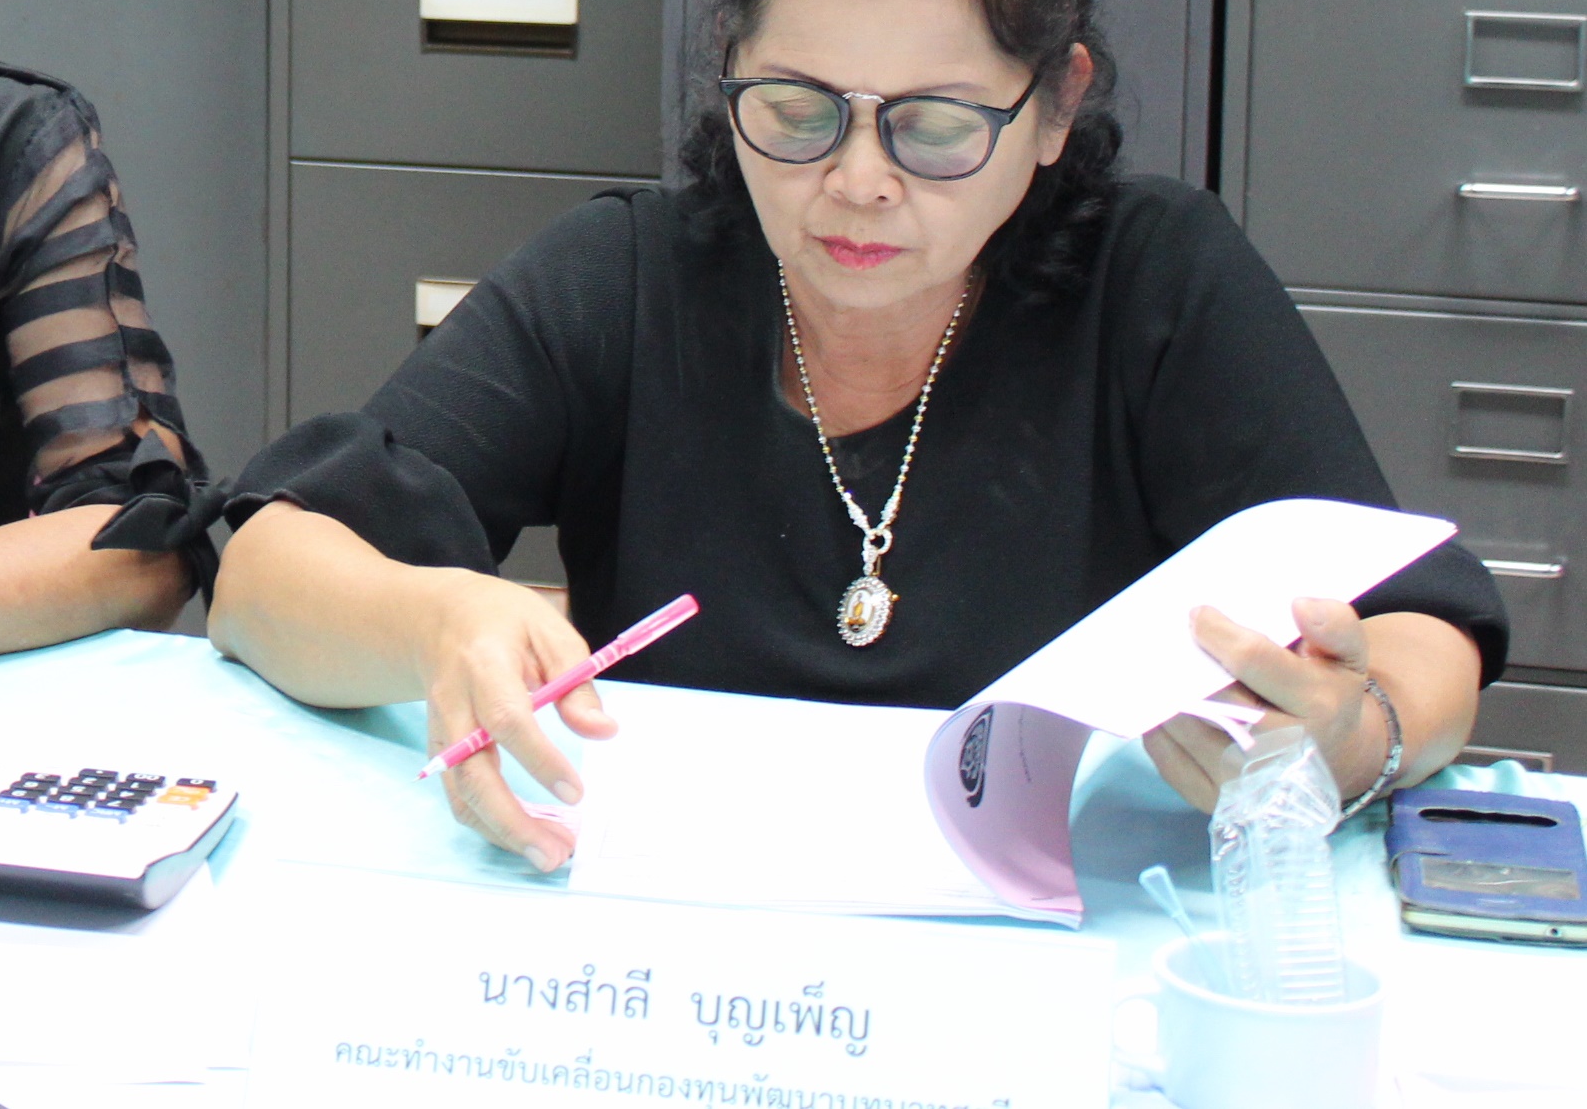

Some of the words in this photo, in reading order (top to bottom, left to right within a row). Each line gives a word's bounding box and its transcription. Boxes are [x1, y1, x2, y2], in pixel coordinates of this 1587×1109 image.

[479, 963, 652, 1019] นางสำลี
[690, 981, 870, 1057] บุญเพ็ญ
